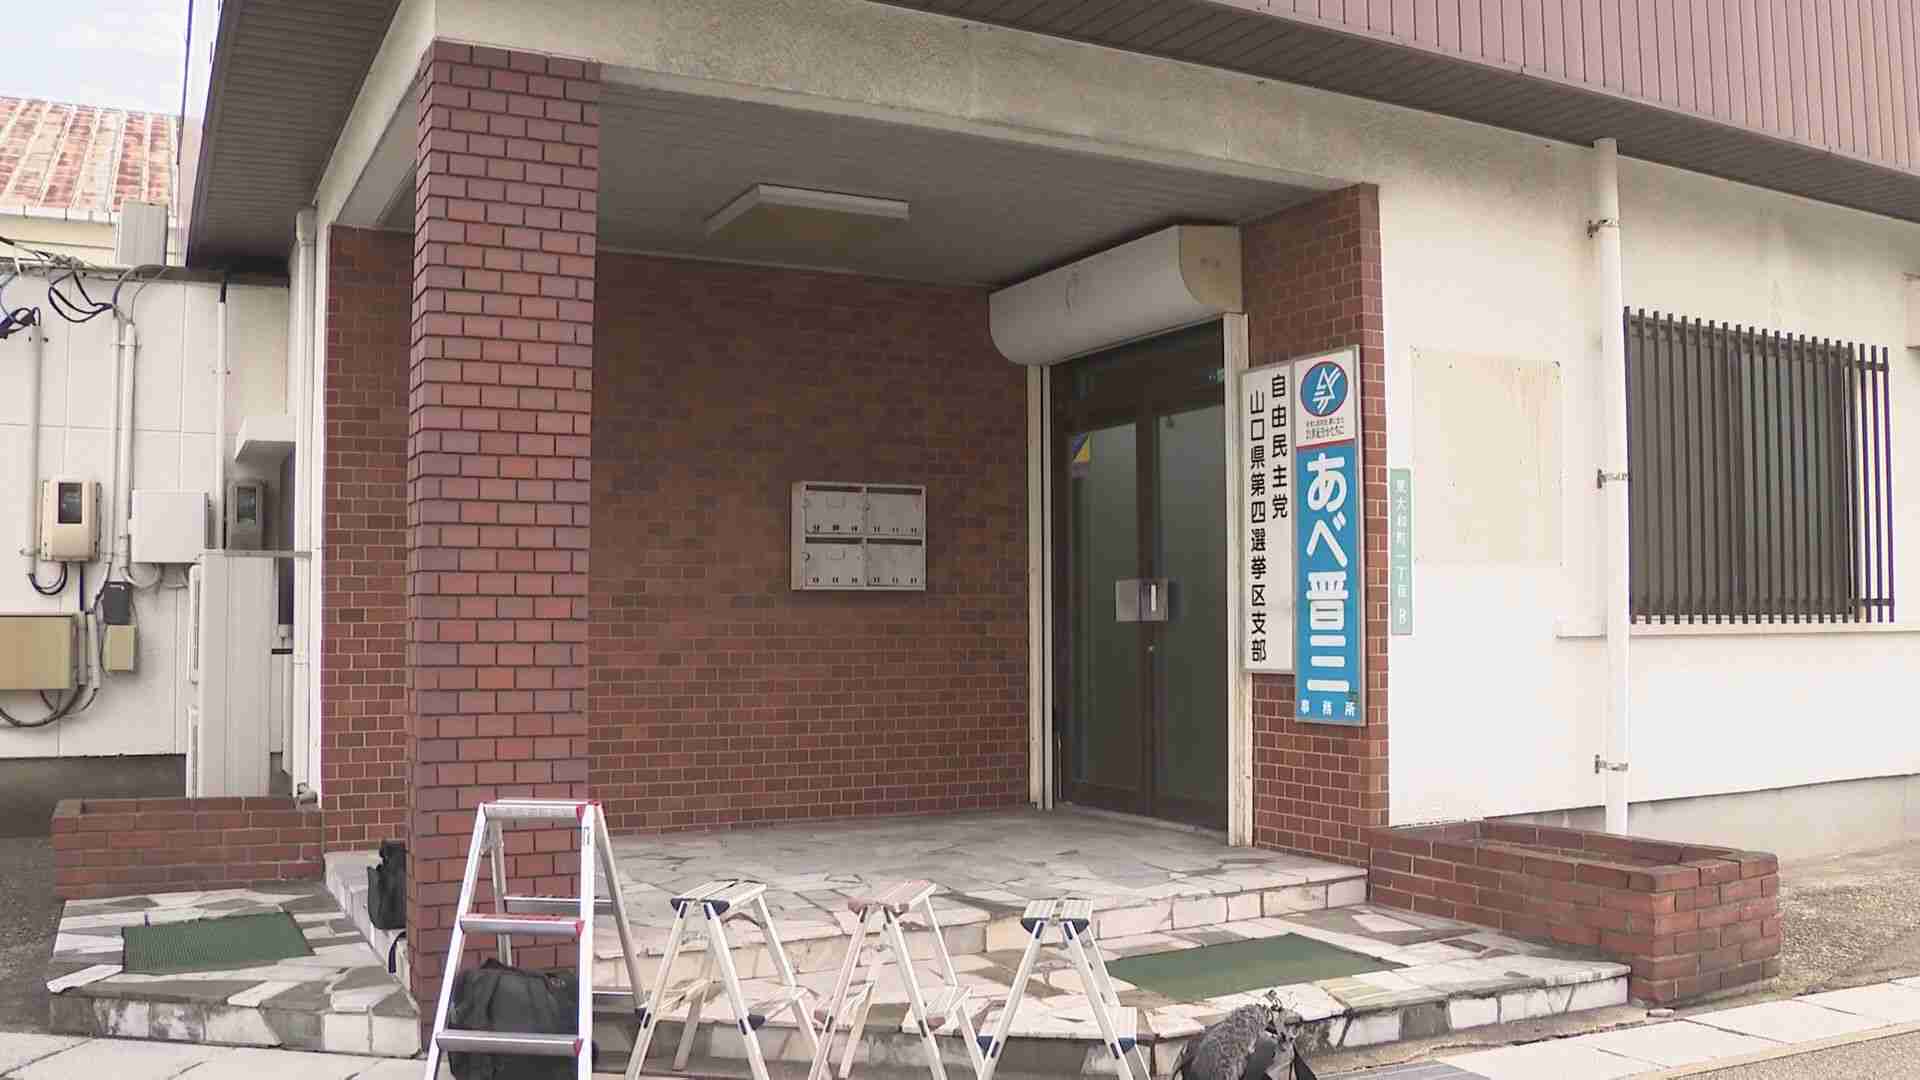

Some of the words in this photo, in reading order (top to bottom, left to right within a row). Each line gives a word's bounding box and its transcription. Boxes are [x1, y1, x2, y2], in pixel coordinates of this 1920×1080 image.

[1250, 389, 1267, 663] 山口県第四選挙区支部
[1271, 373, 1288, 519] 自由民主党
[1306, 452, 1349, 693] あべ晋三
[1300, 699, 1356, 718] 事務所
